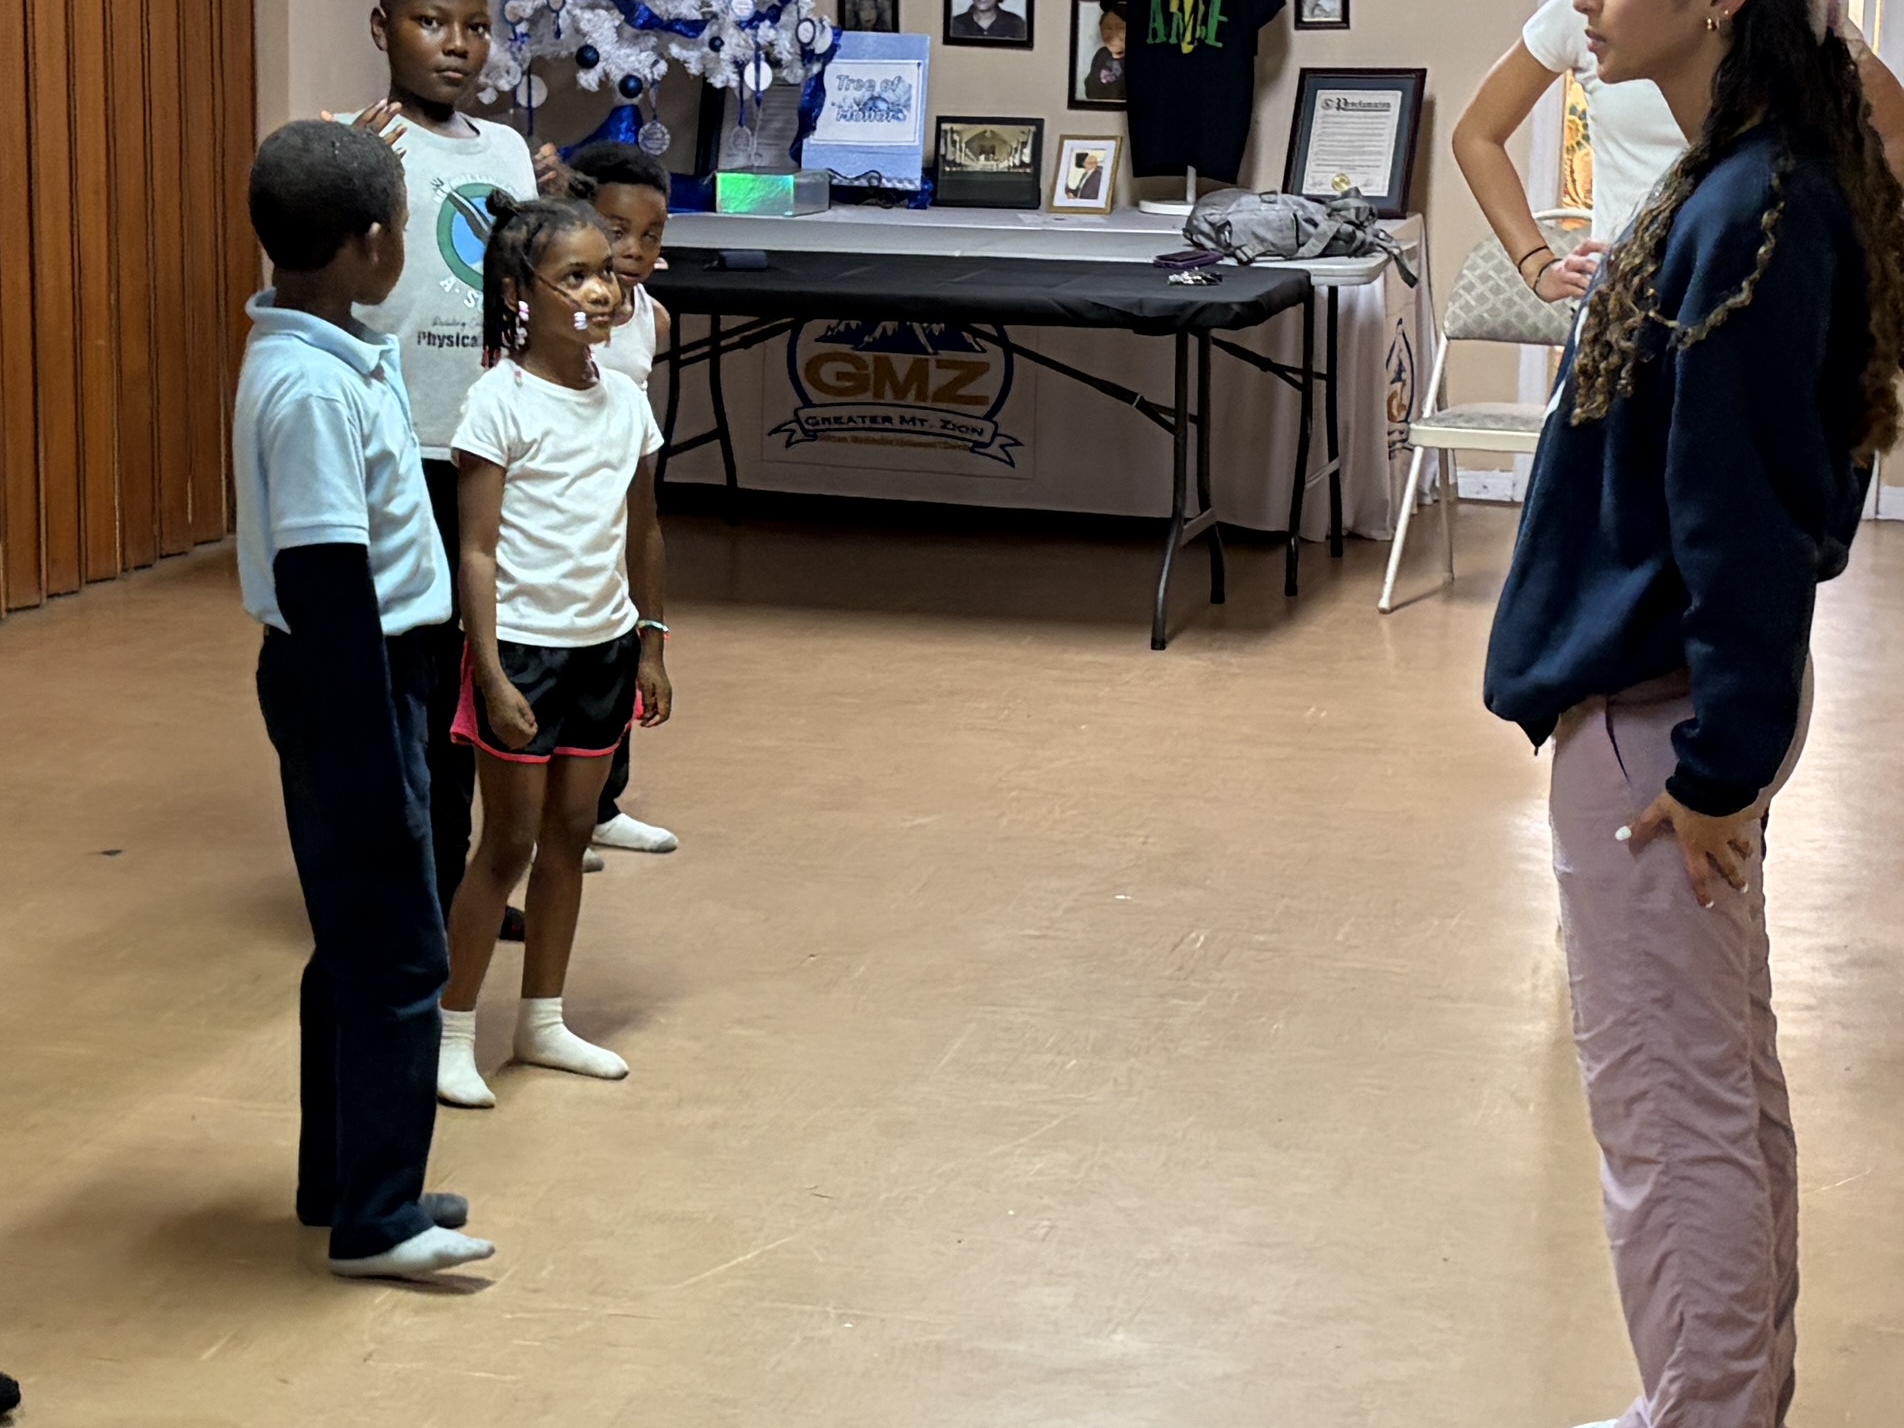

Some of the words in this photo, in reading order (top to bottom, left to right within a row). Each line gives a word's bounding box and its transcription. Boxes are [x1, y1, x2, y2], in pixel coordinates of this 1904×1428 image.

[836, 74, 876, 93] Tree
[879, 75, 902, 93] of
[804, 351, 990, 406] GMZ
[805, 415, 894, 427] GREATER
[939, 418, 985, 437] ZION
